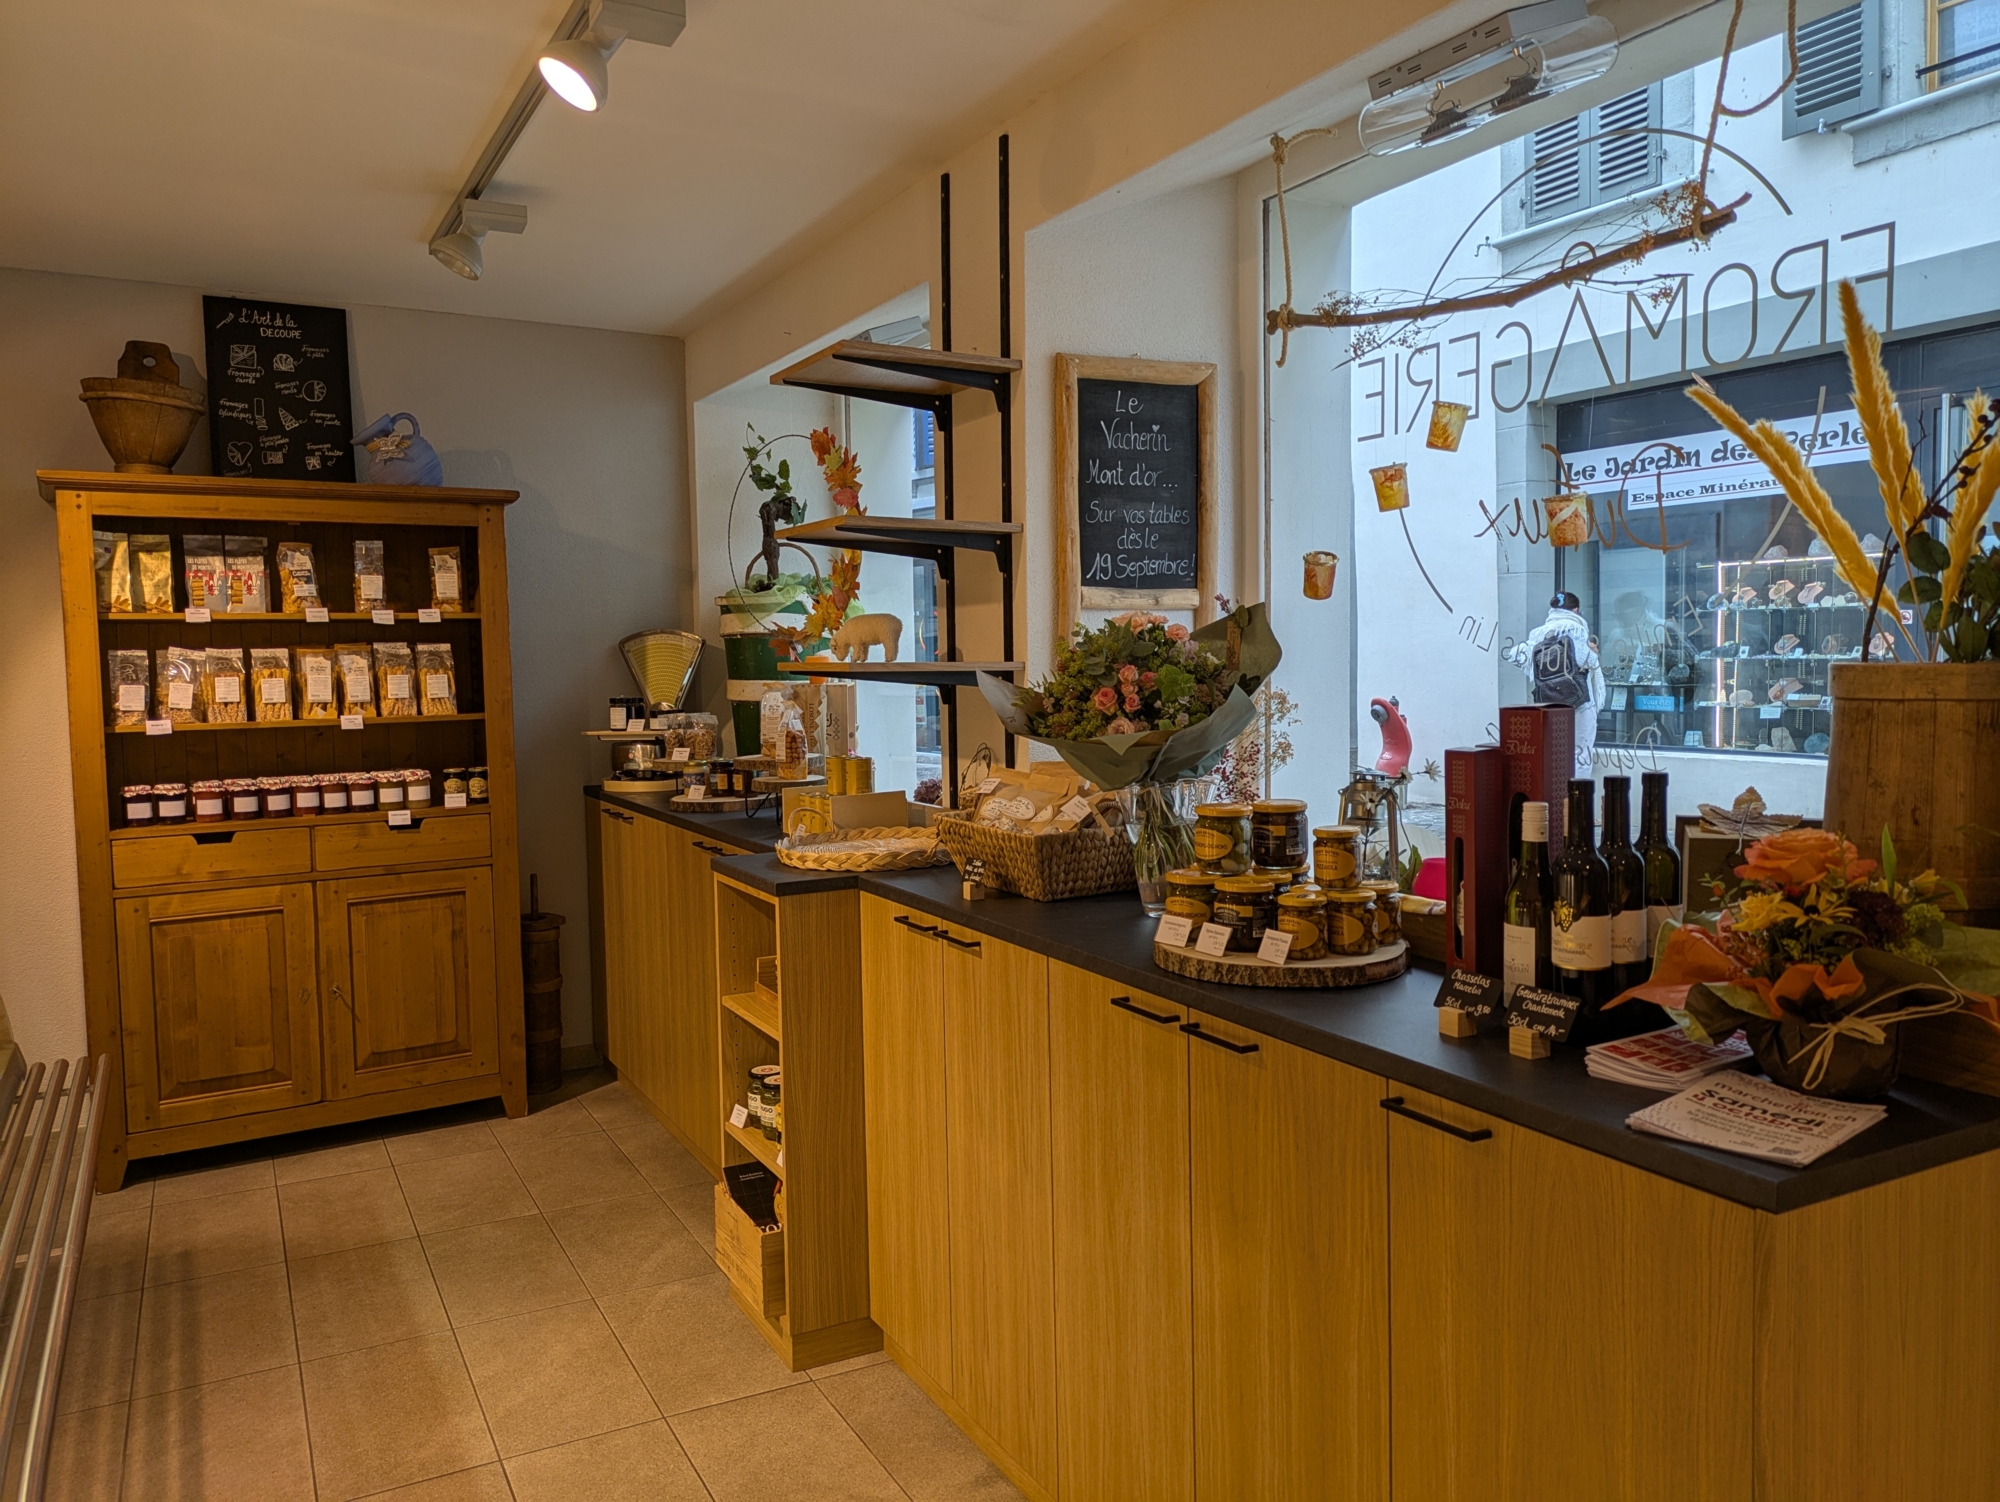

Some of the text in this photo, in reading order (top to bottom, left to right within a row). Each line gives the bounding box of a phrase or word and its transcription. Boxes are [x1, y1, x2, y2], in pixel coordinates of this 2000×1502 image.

[238, 307, 298, 328] L'Art de la
[259, 326, 303, 340] DECOUPE
[227, 367, 261, 383] Fromages
[219, 397, 249, 410] Fromages
[1115, 389, 1144, 415] Le
[1100, 417, 1171, 452] Vacherin
[1565, 460, 1597, 483] Le
[1604, 447, 1701, 480] Jardin
[1783, 421, 1868, 453] erle
[1085, 457, 1126, 487] Mont
[1631, 474, 1783, 506] Espace Minérau
[1085, 500, 1191, 526] Sur vos tables
[1086, 551, 1113, 582] 19
[1451, 968, 1491, 988] Chasselas
[1453, 980, 1482, 996] Marcelin
[1474, 1004, 1491, 1016] 9.50
[1516, 985, 1580, 1011] Gewürztraminer
[1507, 1011, 1528, 1028] 50cl
[1691, 1092, 1706, 1102] 4
[1711, 1101, 1815, 1133] octobre
[1713, 1081, 1857, 1123] marchethon.ch
